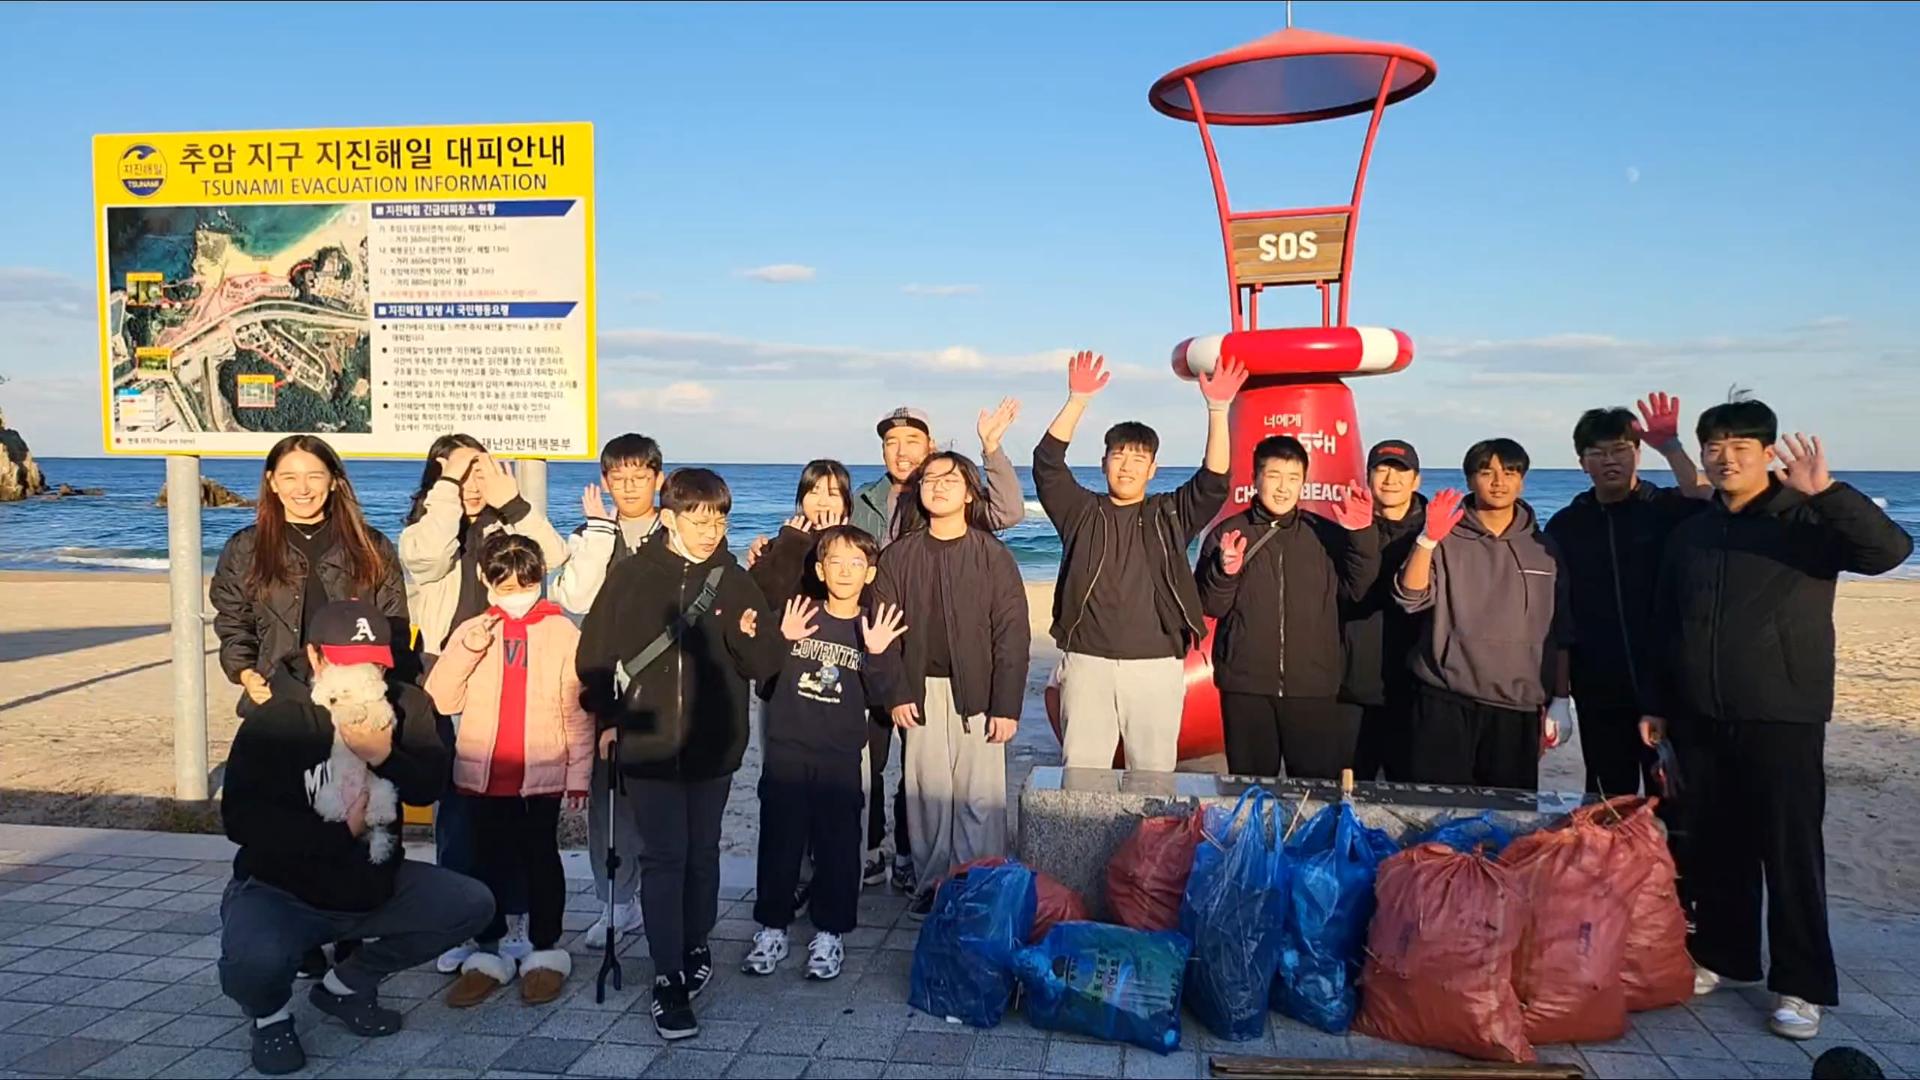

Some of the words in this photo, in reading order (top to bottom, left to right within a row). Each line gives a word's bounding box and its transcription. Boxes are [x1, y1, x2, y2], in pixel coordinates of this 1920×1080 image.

[179, 142, 236, 174] 추암
[248, 142, 304, 172] 지구
[316, 138, 433, 171] 지진해일
[447, 134, 564, 168] 대피안내
[127, 180, 160, 189] TSUNAMI
[202, 179, 284, 197] TSUNAMI
[291, 175, 407, 194] EVACUATION
[414, 173, 548, 193] INFORMATION
[386, 204, 420, 216] 지진해일
[1258, 230, 1319, 262] SOS
[388, 304, 423, 316] 지진해일
[425, 304, 443, 316] 발생
[445, 304, 455, 316] 시
[1263, 412, 1302, 428] 너에게
[351, 617, 377, 641] A
